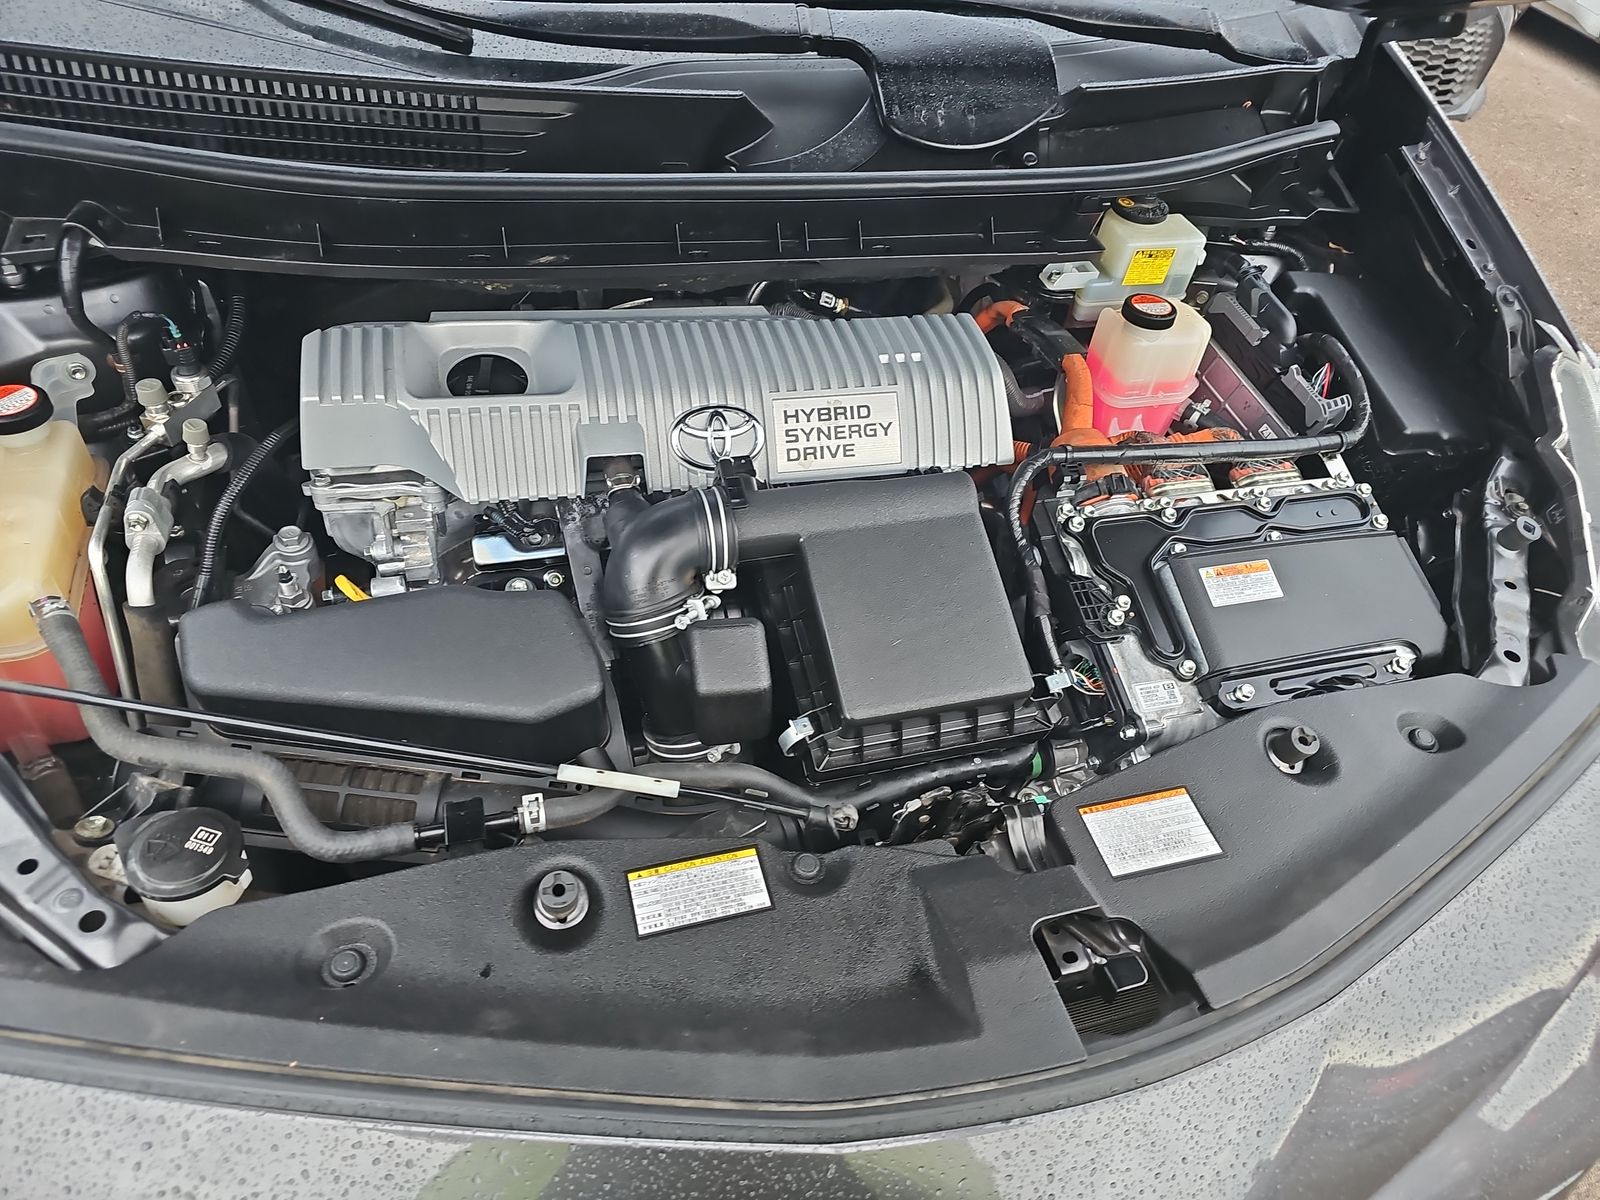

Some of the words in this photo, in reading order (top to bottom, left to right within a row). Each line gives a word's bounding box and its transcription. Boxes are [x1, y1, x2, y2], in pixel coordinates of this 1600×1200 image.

[783, 404, 871, 424] HYBRID
[785, 421, 893, 443] SYNERGY
[786, 443, 856, 462] DRIVE
